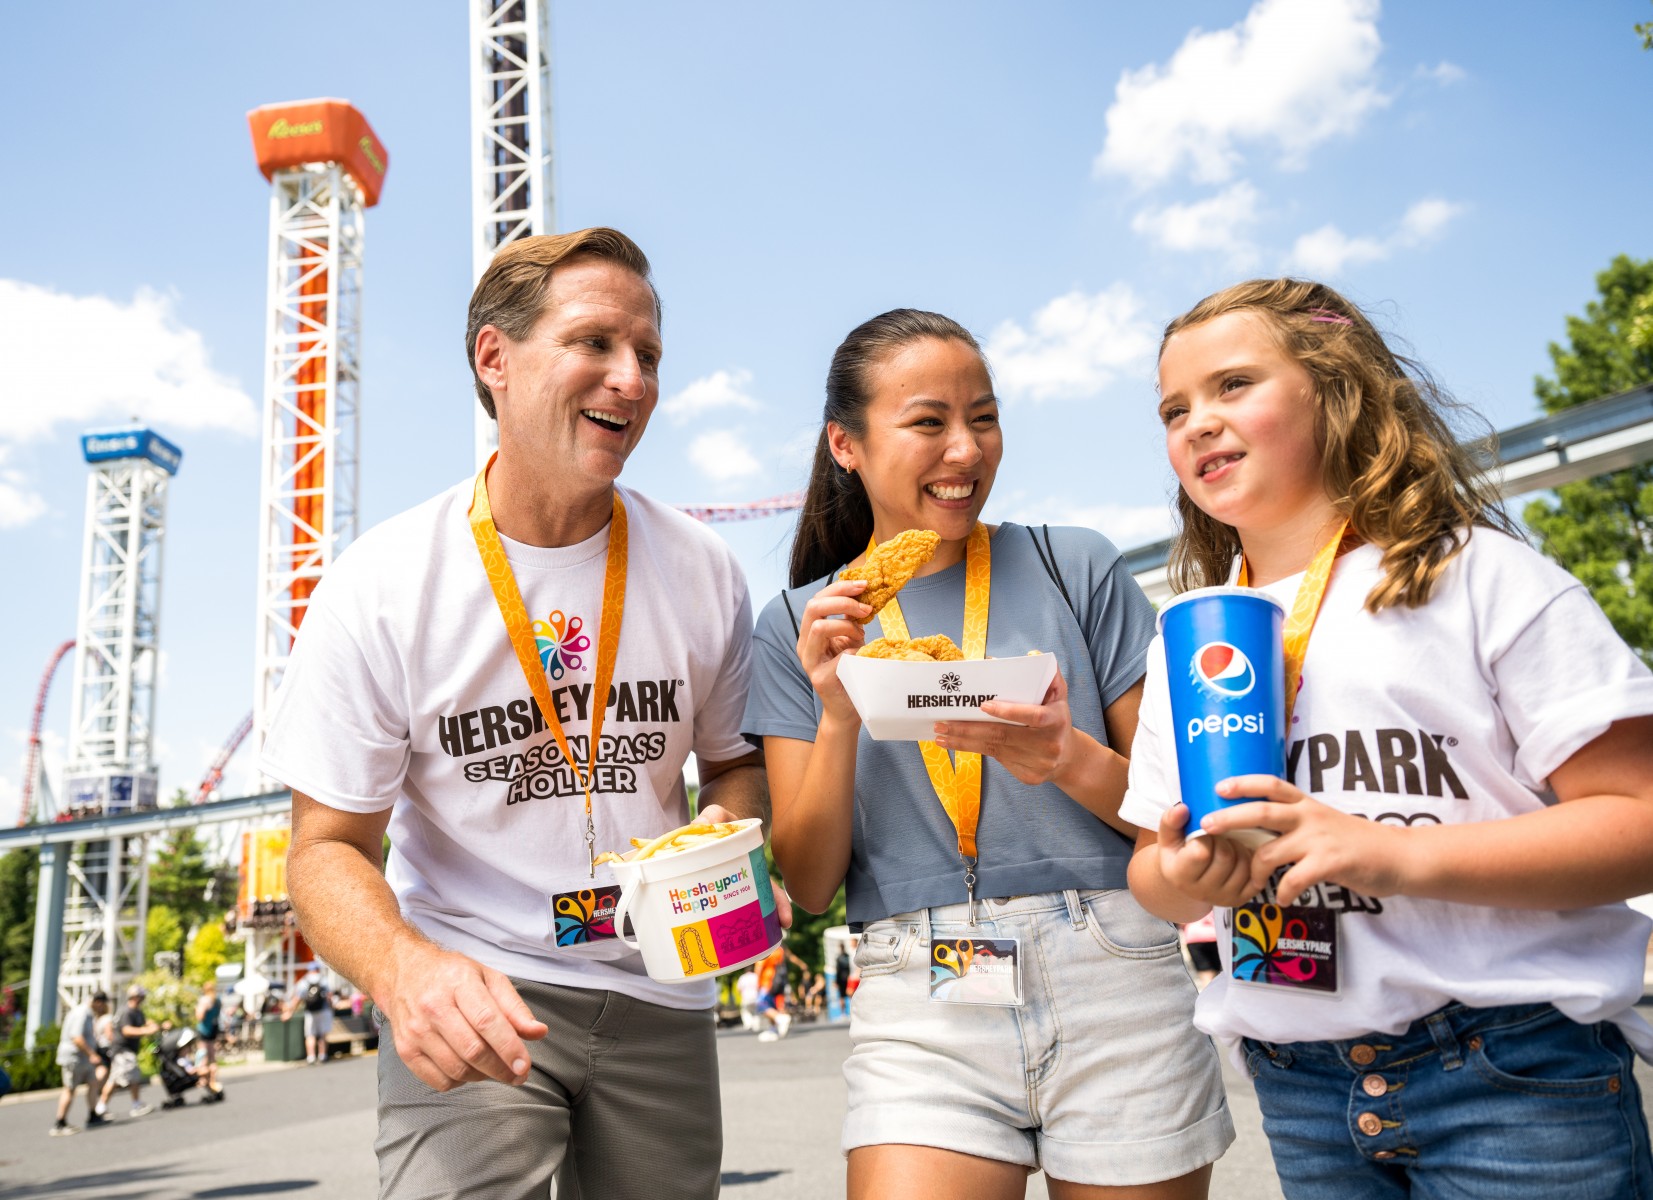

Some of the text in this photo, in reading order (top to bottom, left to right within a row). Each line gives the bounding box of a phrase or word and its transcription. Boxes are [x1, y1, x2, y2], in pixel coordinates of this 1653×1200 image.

[1188, 712, 1264, 743] pepsi
[464, 732, 666, 783] SEASON PASS
[506, 765, 637, 806] HOLDER
[669, 867, 748, 902] Hersheypark
[672, 895, 718, 914] Happy
[723, 889, 739, 900] SINCE
[1277, 938, 1332, 955] HERSHEYPARK
